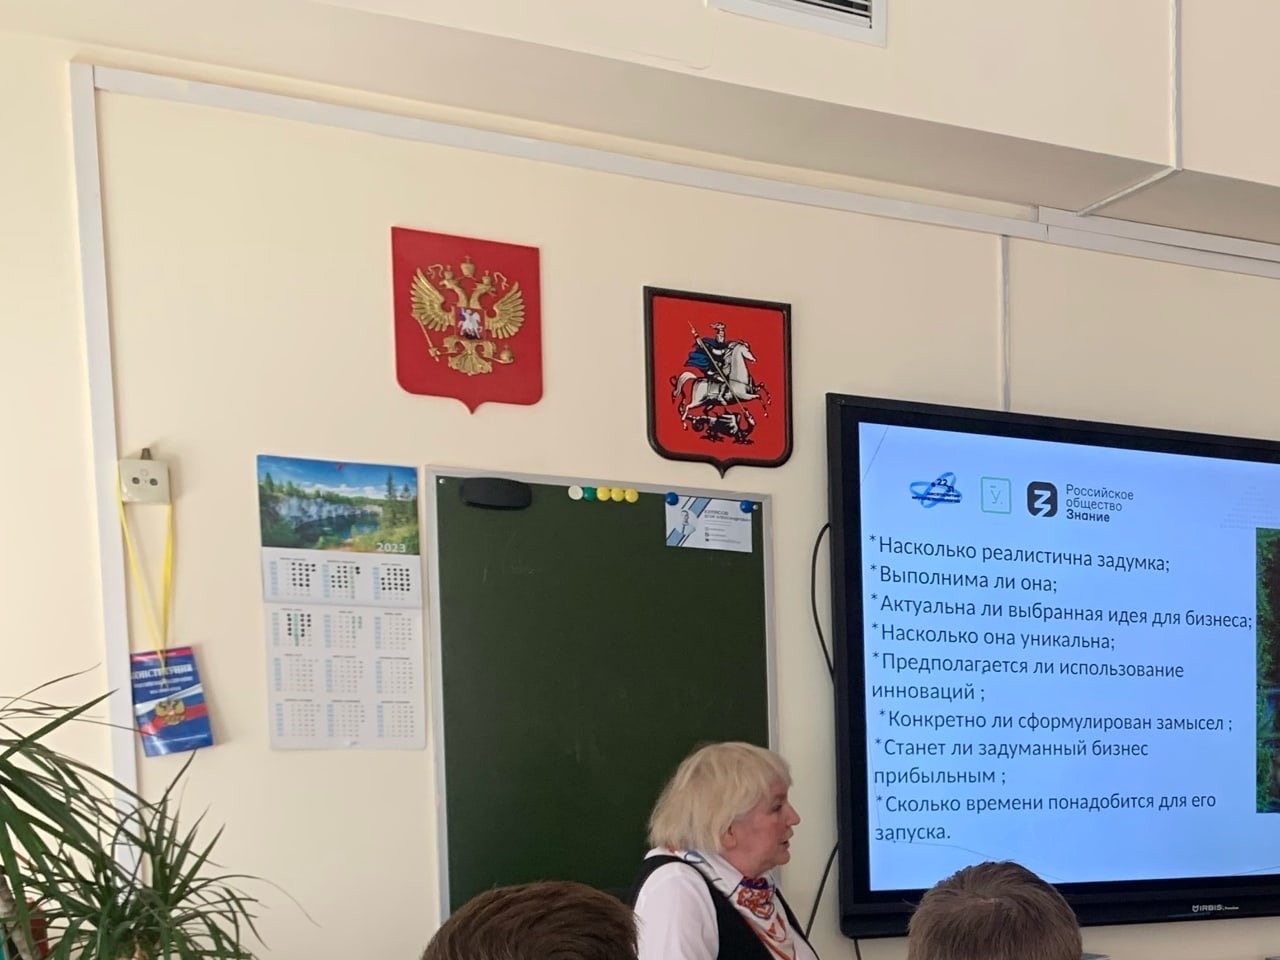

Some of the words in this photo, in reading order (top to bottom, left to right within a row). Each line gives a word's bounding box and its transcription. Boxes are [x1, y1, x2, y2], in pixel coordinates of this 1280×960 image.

[1066, 484, 1133, 500] Российское
[1066, 497, 1122, 511] общество
[1066, 508, 1110, 522] Знание
[376, 543, 406, 553] 2023
[982, 546, 1092, 567] реалистична
[1097, 555, 1169, 573] задумка;
[993, 576, 1015, 589] ли
[1021, 578, 1056, 594] она;
[981, 604, 1002, 619] ли
[1008, 602, 1103, 623] выбранная
[1109, 610, 1147, 626] идея
[1152, 612, 1181, 628] для
[1185, 610, 1252, 630] бизнеса;
[984, 632, 1016, 646] она
[1020, 632, 1114, 651] уникальна;
[1033, 662, 1054, 674] ли
[1060, 662, 1184, 678] использование
[872, 682, 974, 703] инноваций
[991, 716, 1013, 728] ли
[1018, 712, 1152, 733] сформулирован
[1156, 717, 1223, 731] замысел
[951, 743, 973, 755] ли
[978, 739, 1087, 759] задуманный
[1092, 740, 1148, 756] бизнес
[874, 767, 995, 787] прибыльным
[966, 798, 1043, 814] времени
[1049, 793, 1154, 812] понадобится
[1158, 796, 1187, 811] для
[1192, 796, 1216, 807] его
[875, 821, 950, 843] запуска.
